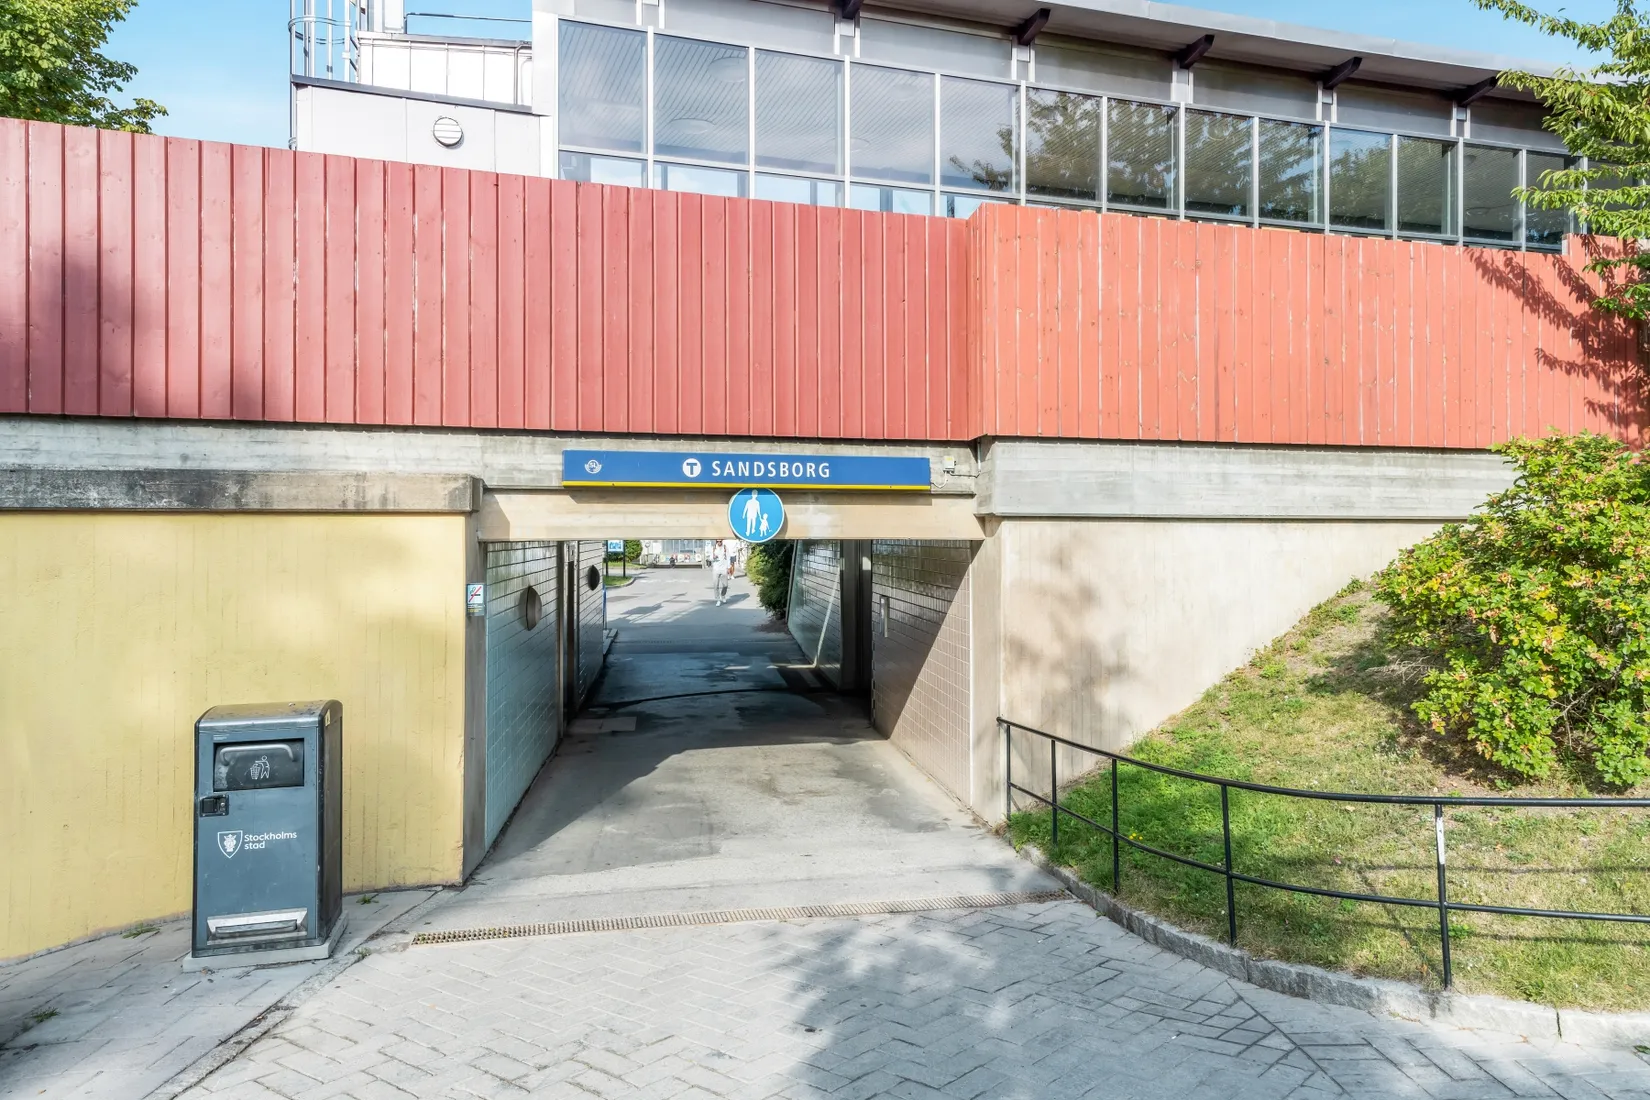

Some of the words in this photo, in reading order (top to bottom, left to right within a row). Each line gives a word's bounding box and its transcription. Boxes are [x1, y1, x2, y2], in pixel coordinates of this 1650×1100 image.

[685, 461, 699, 477] T
[711, 460, 830, 478] SANDSBORG
[244, 831, 297, 842] Stockholms
[244, 841, 265, 849] stad
